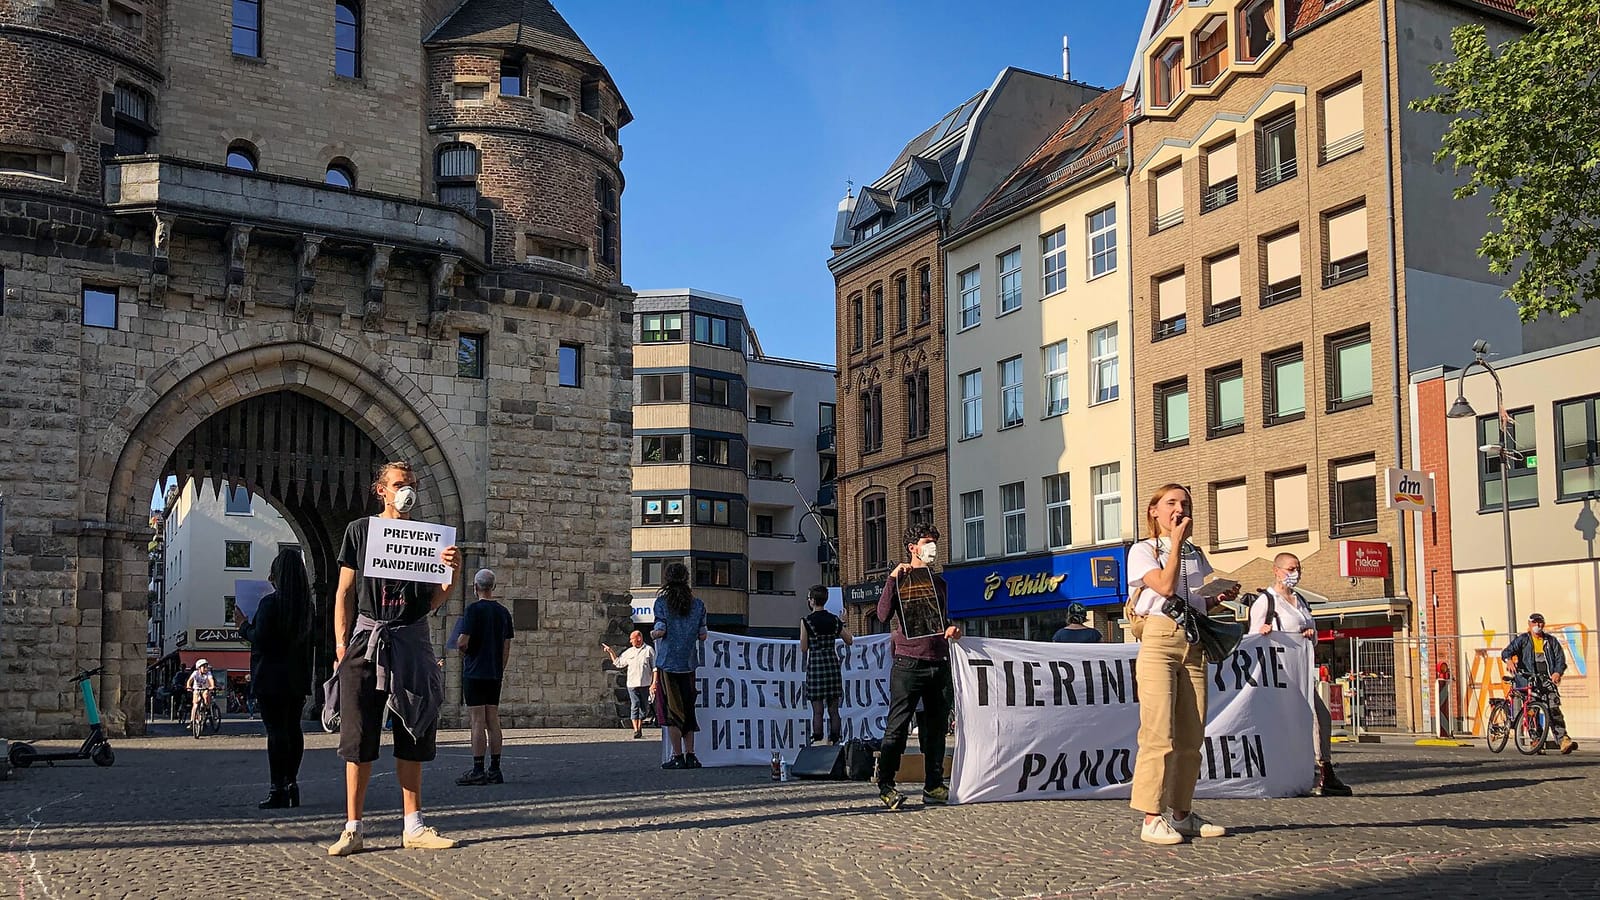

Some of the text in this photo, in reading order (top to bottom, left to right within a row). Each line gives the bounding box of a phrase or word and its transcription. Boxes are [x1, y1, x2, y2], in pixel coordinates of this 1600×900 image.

[1399, 475, 1421, 494] dm
[383, 528, 441, 542] PREVENT
[386, 543, 436, 557] FUTURE
[372, 558, 446, 574] PANDEMICS
[1355, 556, 1382, 567] rieker
[1006, 573, 1066, 597] Tchibo
[968, 646, 1288, 707] TIERINRIE
[1016, 735, 1267, 793] PANDIEN
